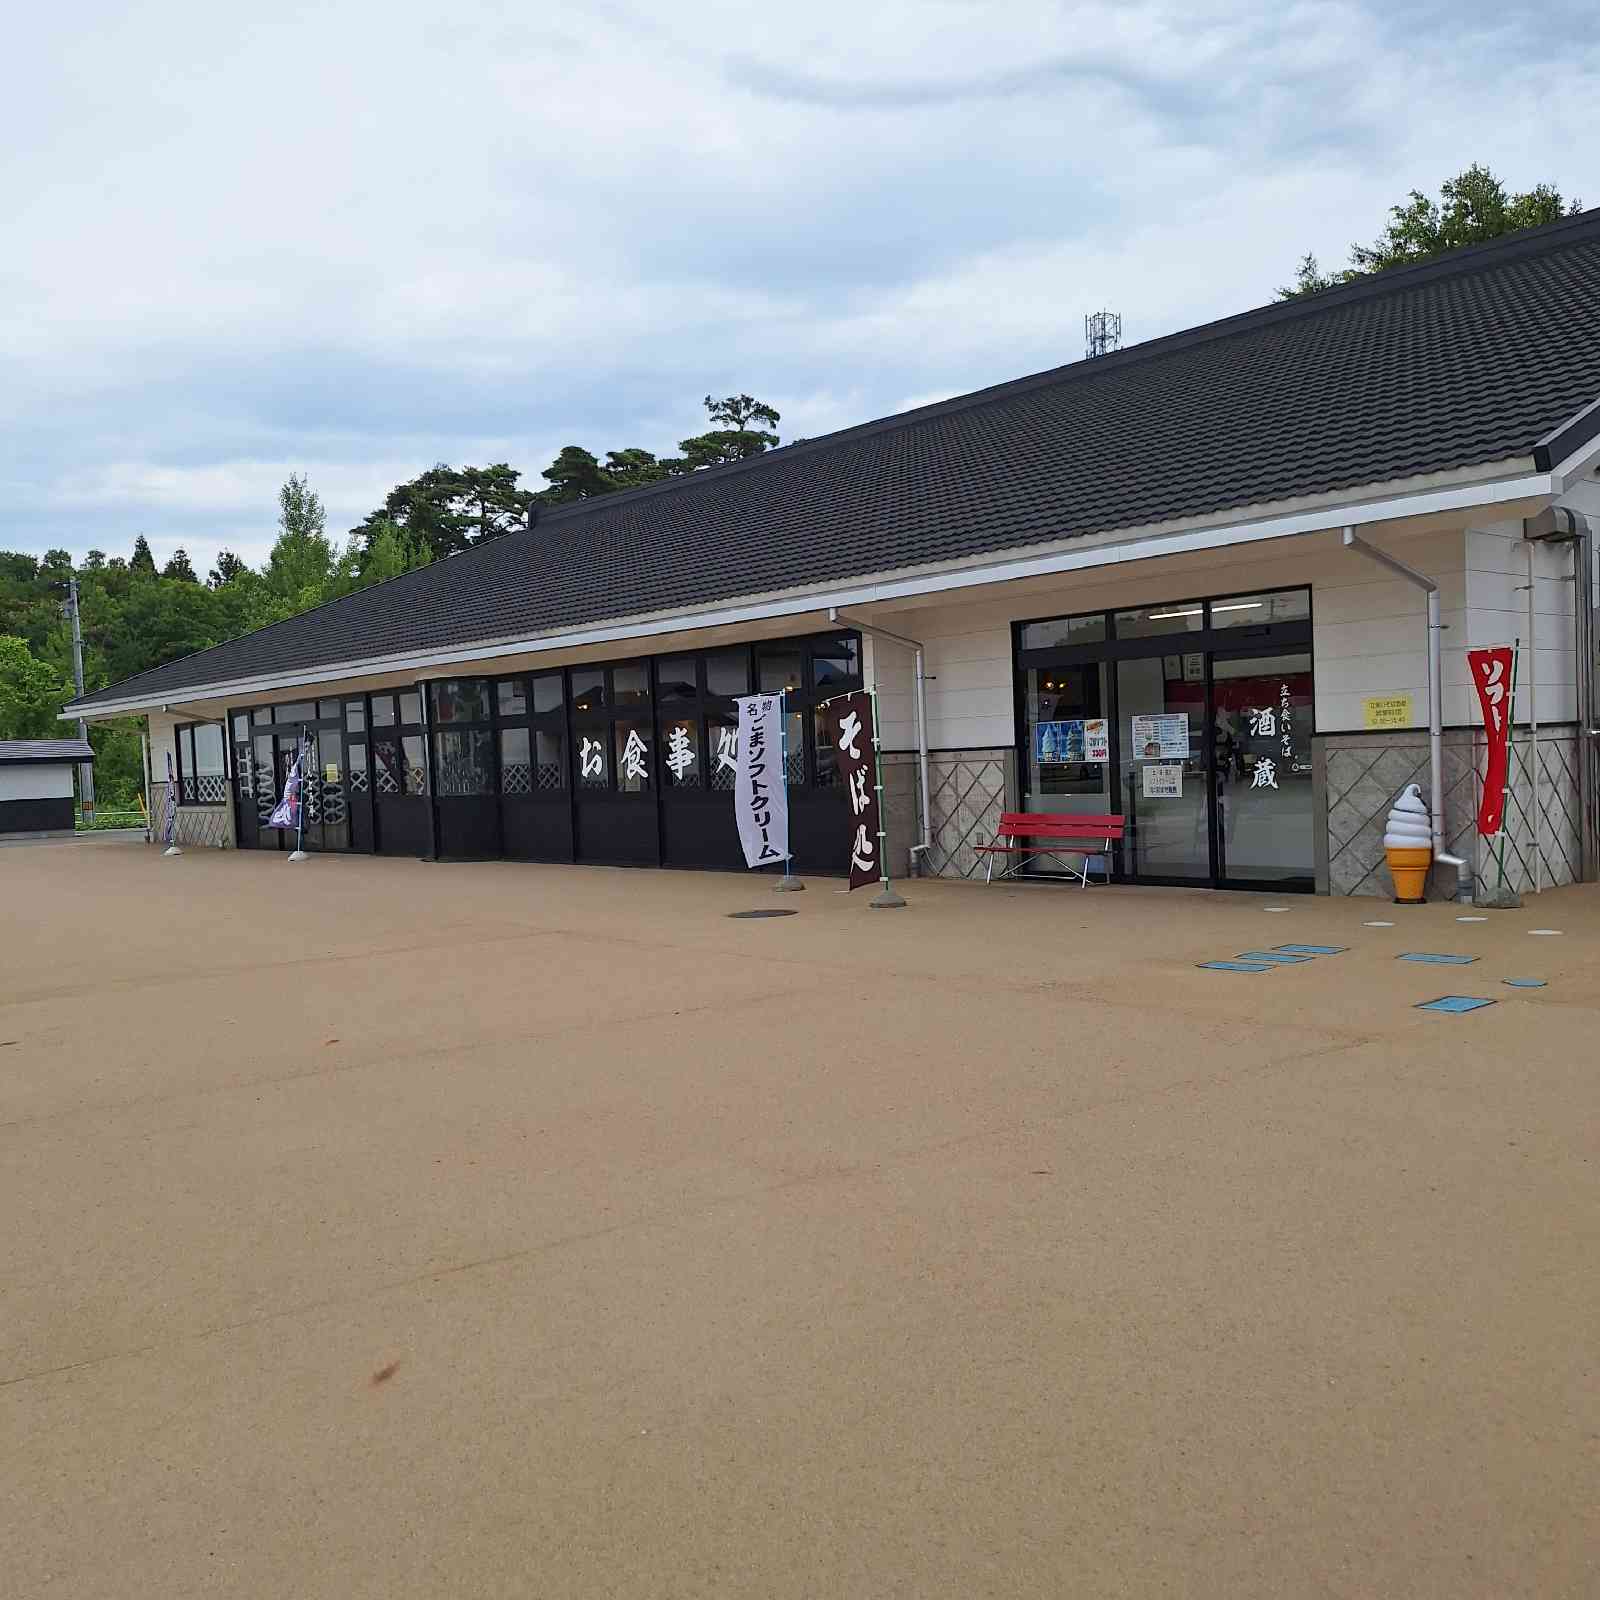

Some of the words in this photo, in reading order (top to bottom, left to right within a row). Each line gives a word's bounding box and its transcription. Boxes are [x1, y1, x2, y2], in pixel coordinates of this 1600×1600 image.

[748, 714, 781, 860] ごまソフトクリーム
[1249, 707, 1280, 790] 酒蔵
